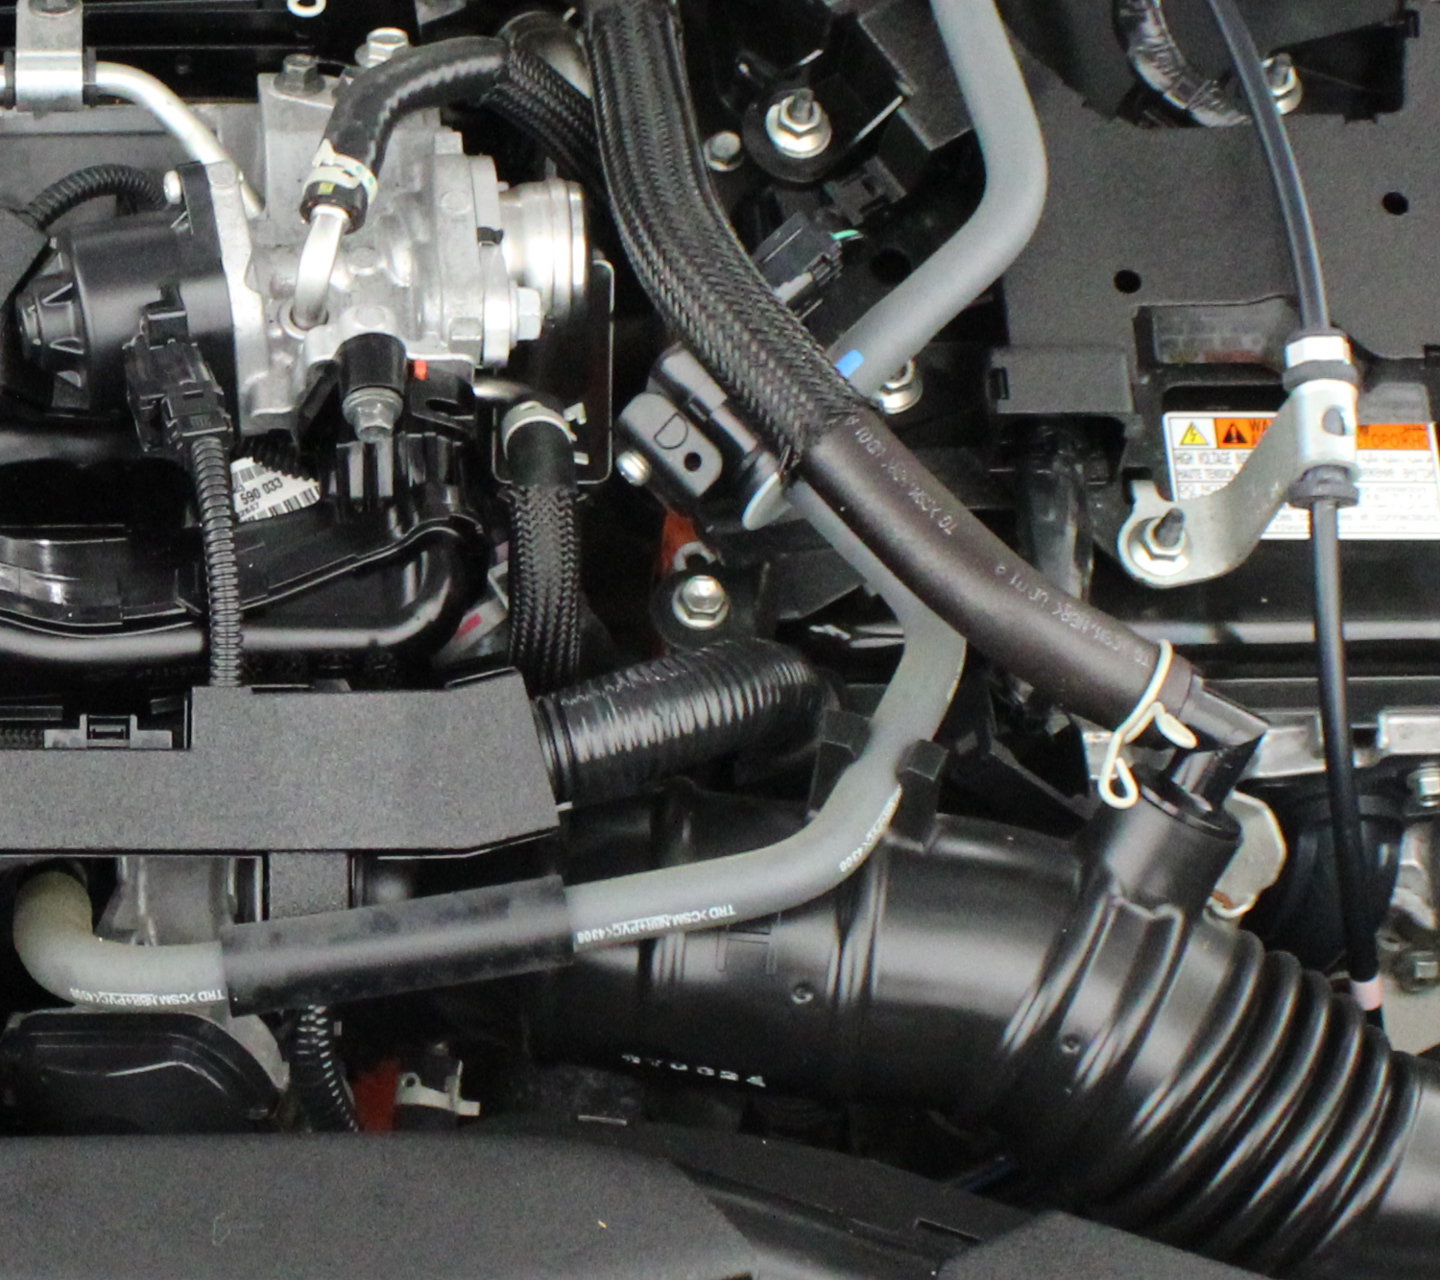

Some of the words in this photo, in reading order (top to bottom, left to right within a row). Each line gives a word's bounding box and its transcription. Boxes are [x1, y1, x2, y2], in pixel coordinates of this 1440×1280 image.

[262, 477, 284, 495] 033
[708, 903, 737, 920] TRD
[197, 988, 225, 1003] TRD
